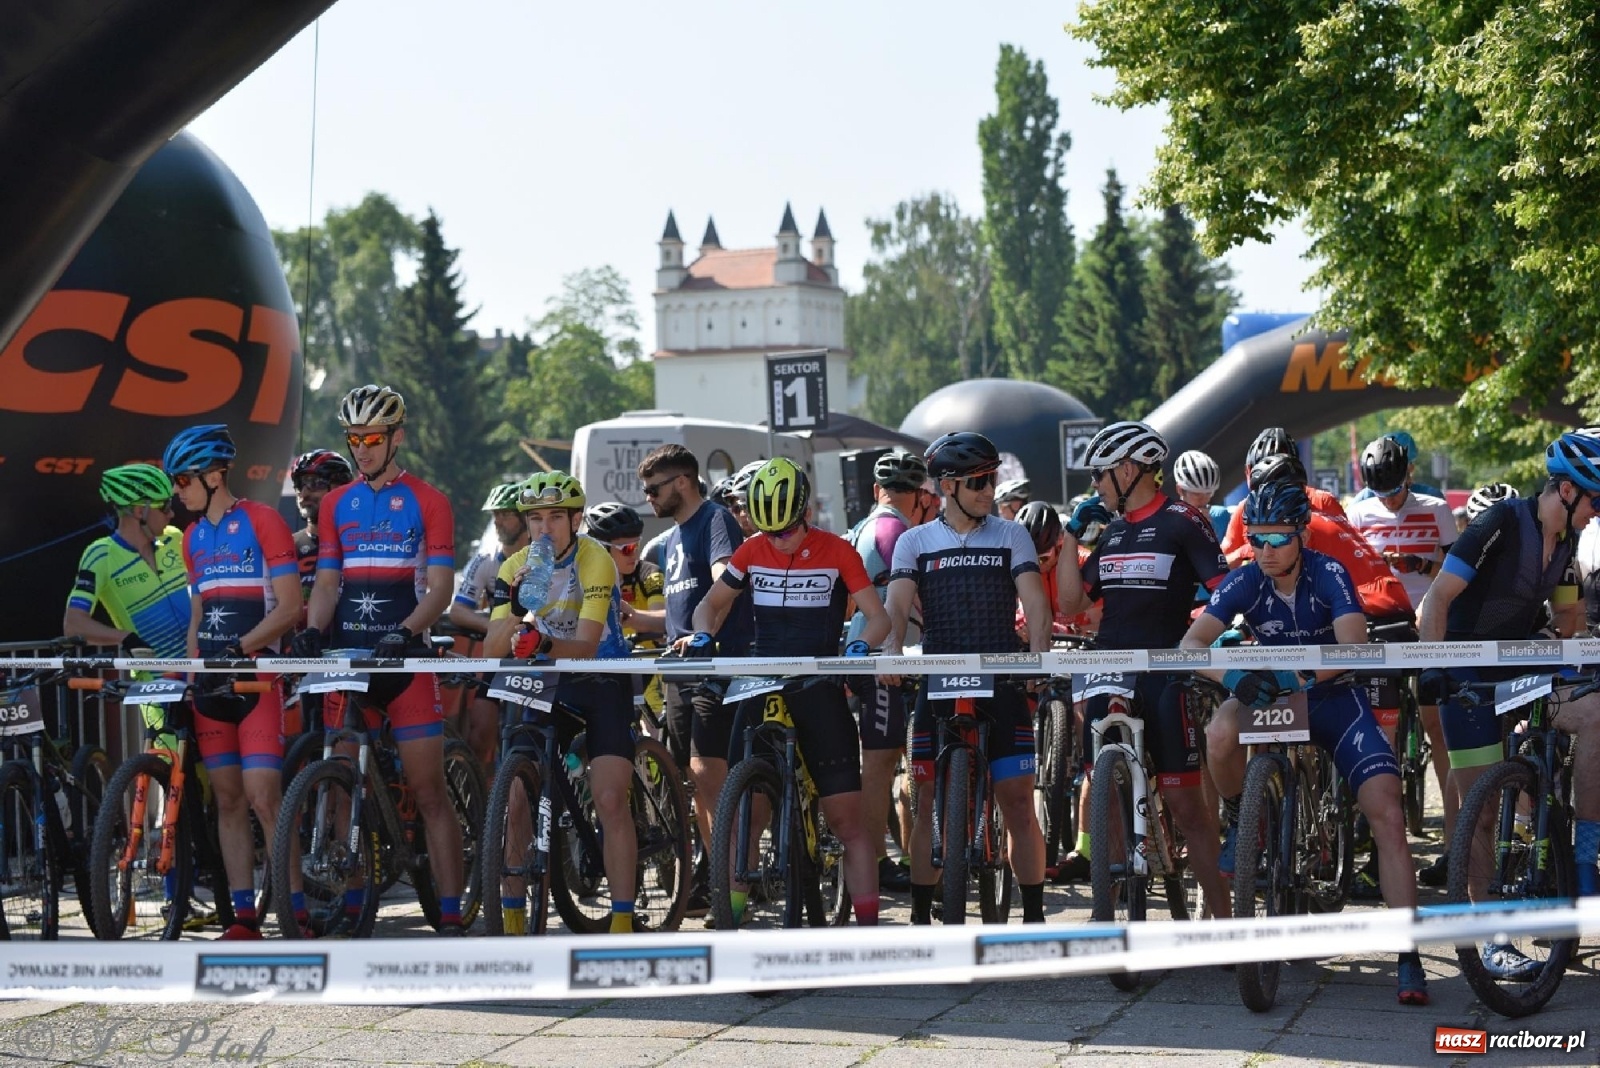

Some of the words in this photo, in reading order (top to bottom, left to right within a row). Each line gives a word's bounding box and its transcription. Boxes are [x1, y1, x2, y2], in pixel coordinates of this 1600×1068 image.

[774, 362, 820, 375] SEKTOR
[784, 377, 816, 426] 1
[34, 457, 94, 474] CST
[938, 555, 1002, 568] BICICLISTA
[115, 572, 149, 587] Energo
[666, 577, 699, 598] VERSE
[139, 683, 175, 693] 1034
[505, 675, 544, 693] 1699
[941, 676, 982, 688] 1465
[0, 704, 29, 719] 036
[1253, 708, 1294, 726] 2120
